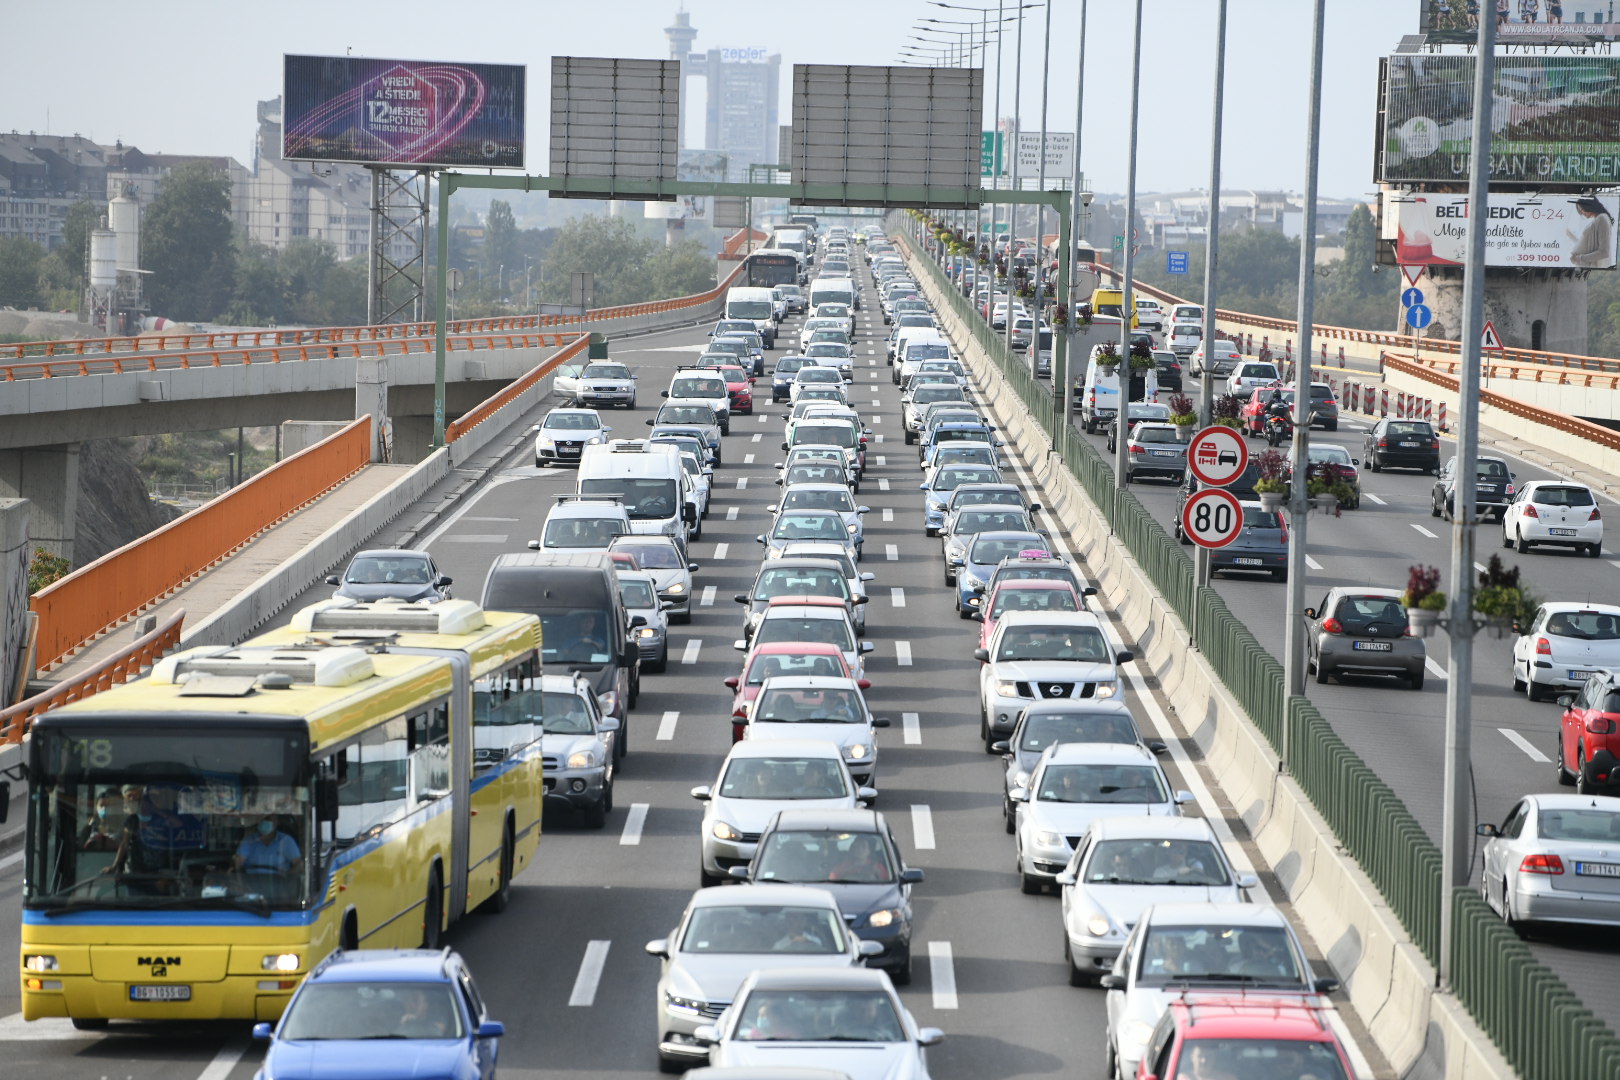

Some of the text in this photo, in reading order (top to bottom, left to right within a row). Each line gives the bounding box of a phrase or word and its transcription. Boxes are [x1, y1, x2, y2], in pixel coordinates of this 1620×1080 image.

[382, 76, 415, 87] VREDI
[366, 100, 390, 123] 12
[389, 106, 428, 117] MESECI
[410, 116, 427, 126] DIN
[1486, 206, 1525, 220] EDIC
[1532, 208, 1565, 221] 0-24
[1433, 223, 1466, 240] Moje
[1517, 254, 1535, 262] 309
[1537, 254, 1560, 262] 1000
[1195, 503, 1231, 533] 80
[72, 738, 113, 769] 18
[137, 956, 181, 966] MAN
